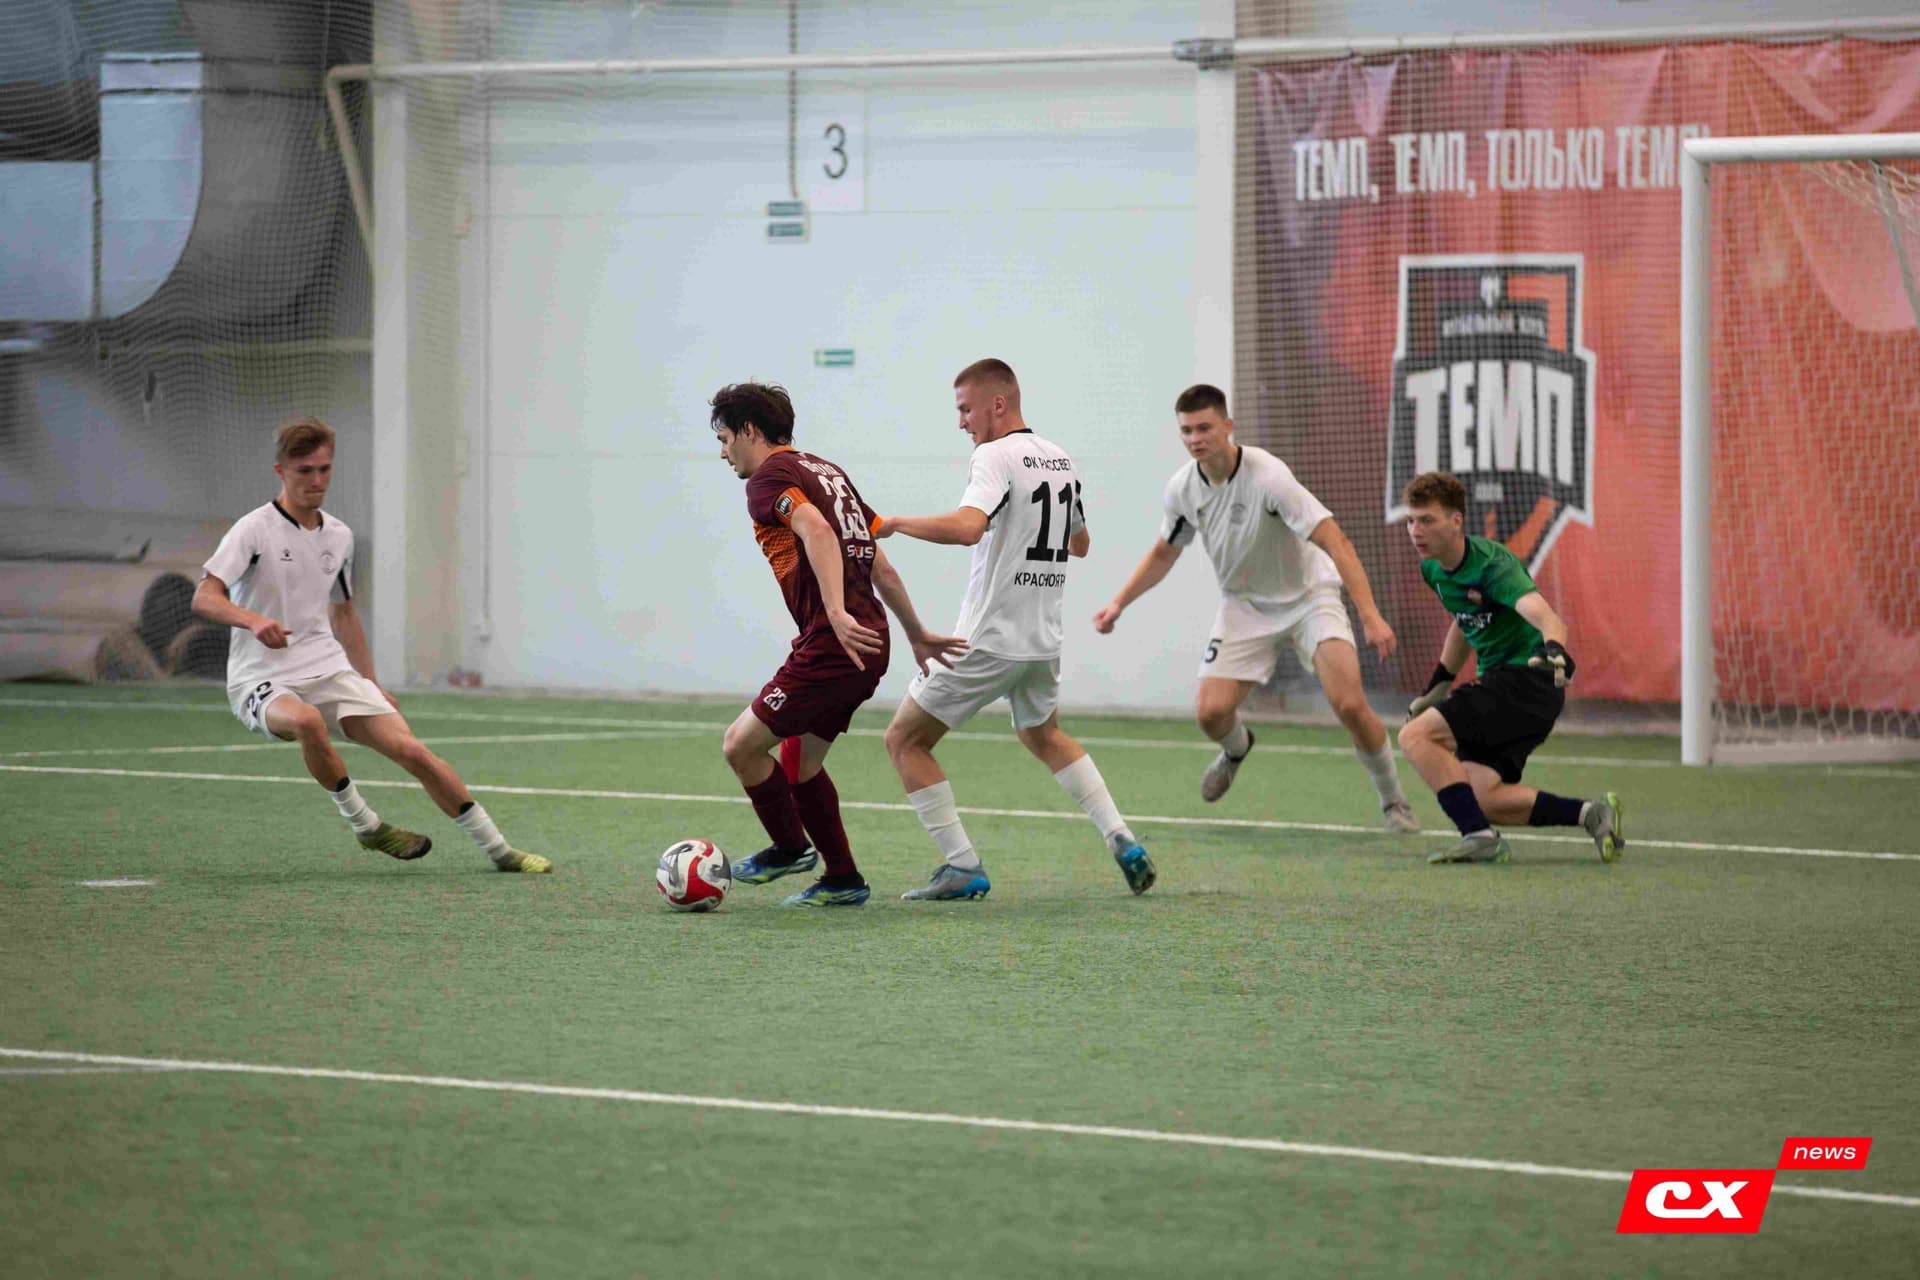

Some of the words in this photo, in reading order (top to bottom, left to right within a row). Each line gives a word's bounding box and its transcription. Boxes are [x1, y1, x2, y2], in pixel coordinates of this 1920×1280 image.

[823, 123, 848, 179] 3
[1294, 137, 1379, 203] ТЕМП,
[1389, 131, 1476, 197] ТЕМП,
[1486, 127, 1604, 190] ТОЛЬКО
[1616, 124, 1710, 189] ТЕМ
[1406, 361, 1573, 486] ТЕМП
[1023, 456, 1039, 468] ФК
[1026, 481, 1073, 562] 11
[763, 687, 787, 711] 23
